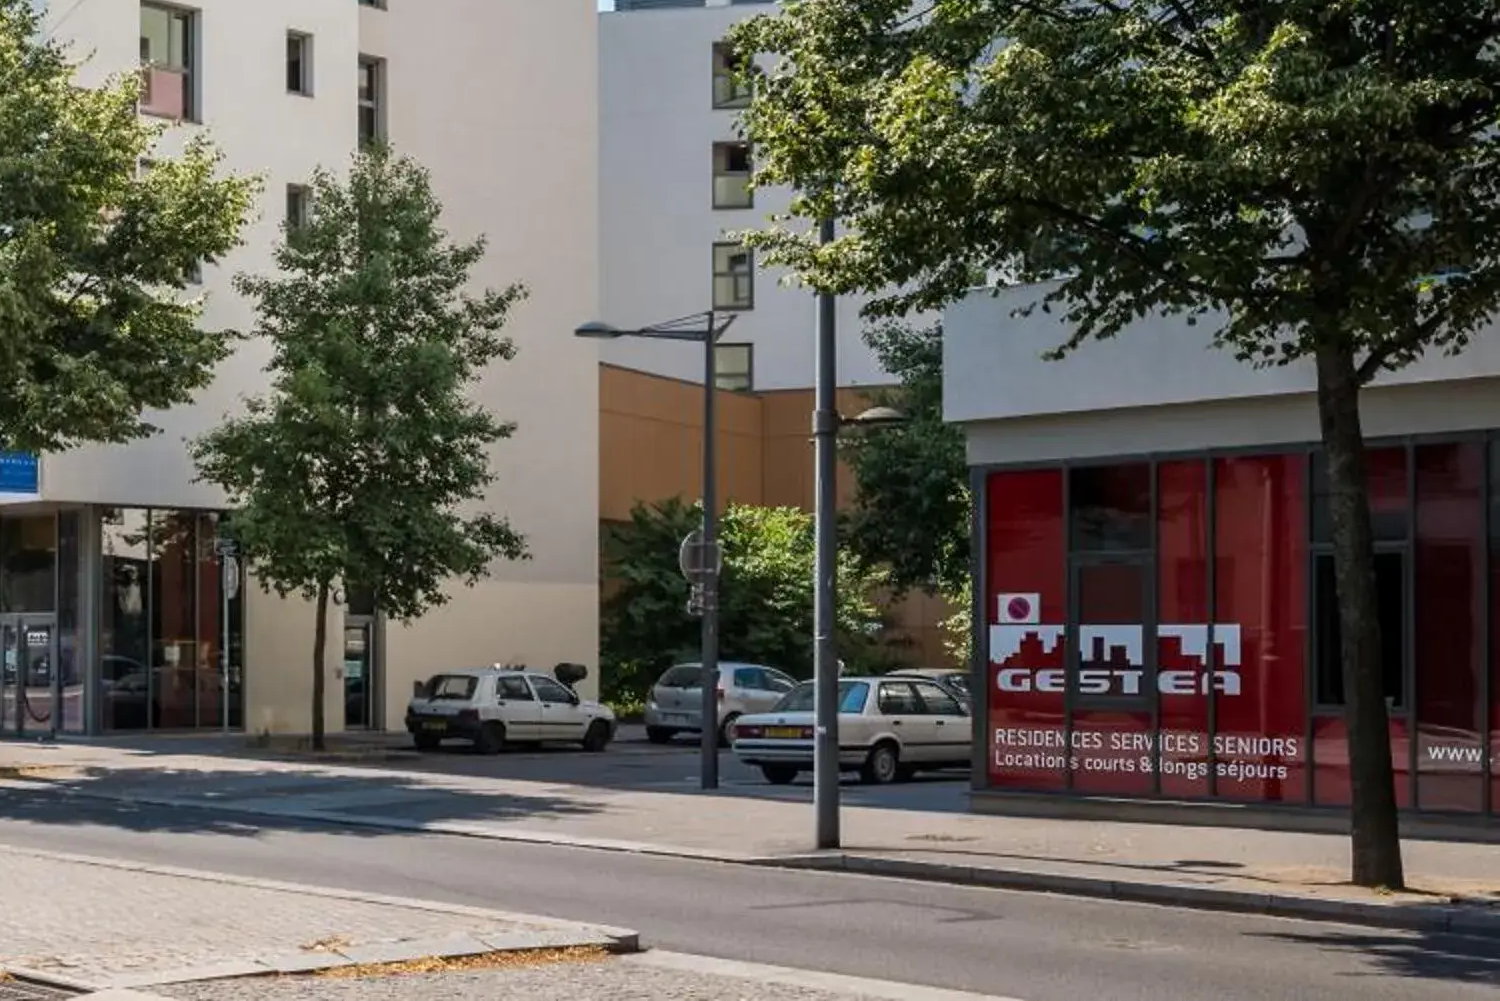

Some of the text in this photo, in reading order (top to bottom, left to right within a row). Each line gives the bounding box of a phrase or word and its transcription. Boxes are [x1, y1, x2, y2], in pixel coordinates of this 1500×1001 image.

[997, 668, 1241, 696] GESTEA
[995, 728, 1298, 757] RESIDENCES SERVICES SENIORS
[995, 750, 1288, 782] Locations courts & longs séjours
